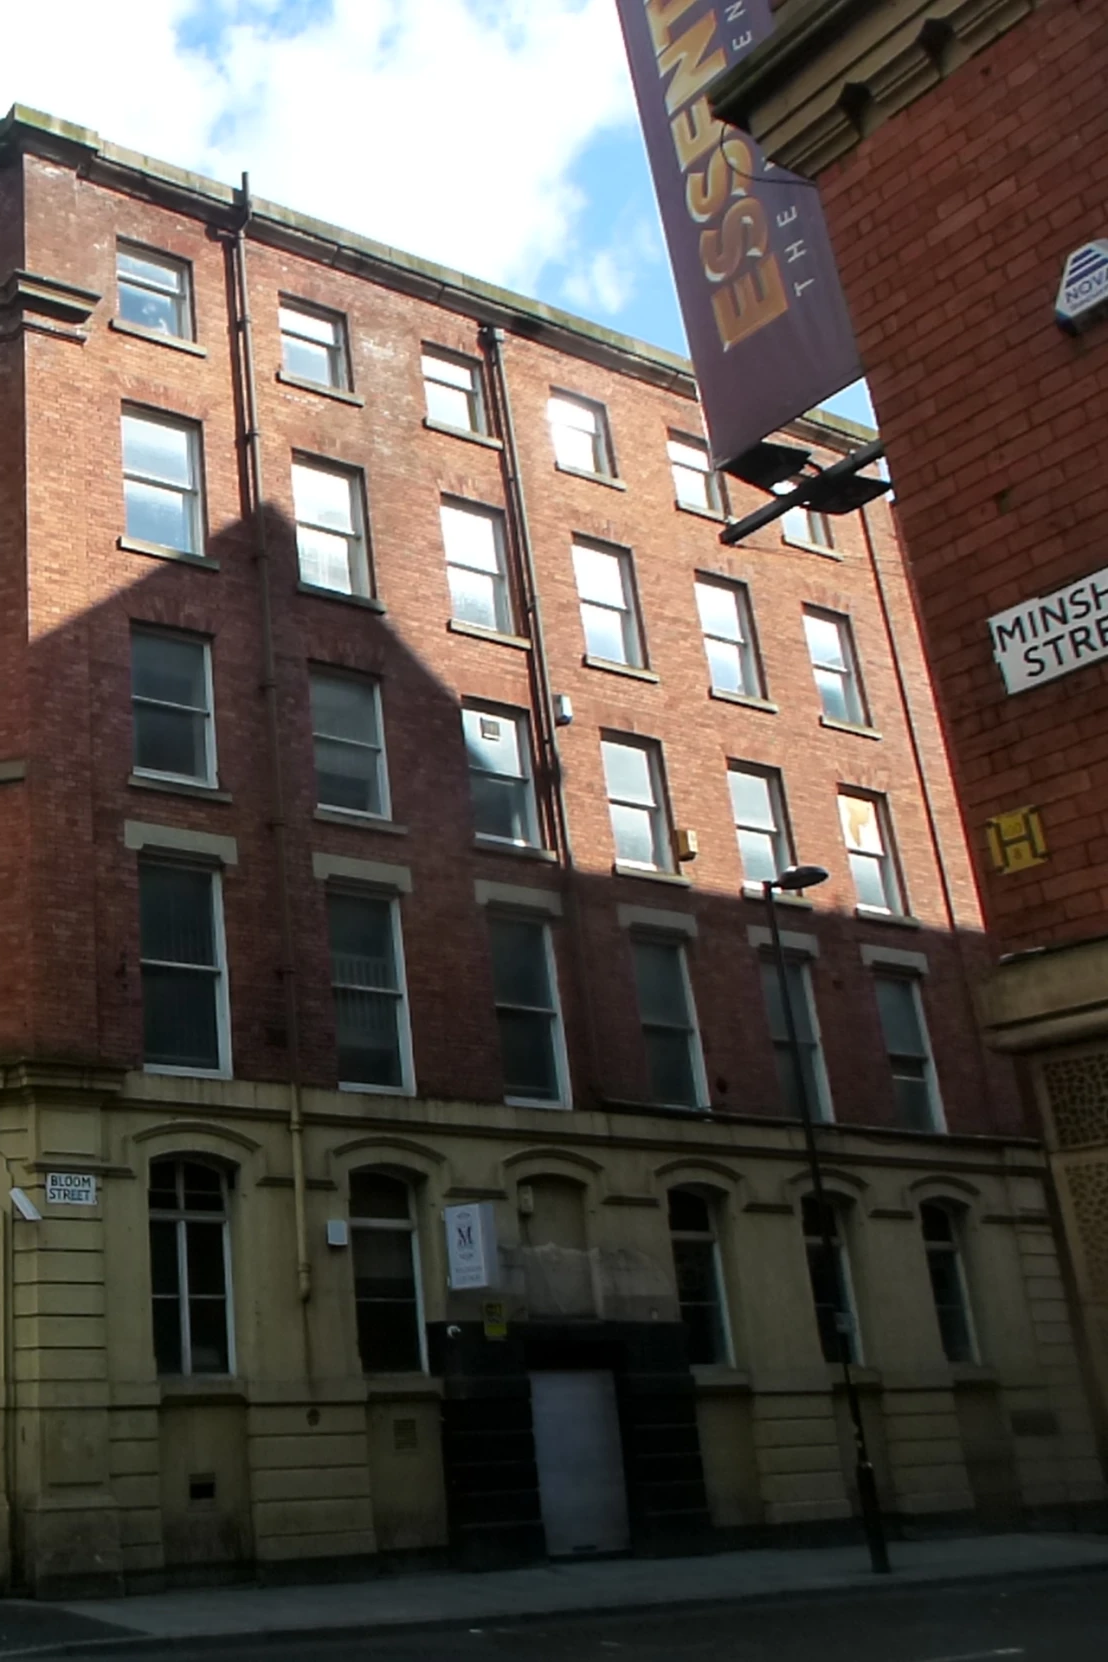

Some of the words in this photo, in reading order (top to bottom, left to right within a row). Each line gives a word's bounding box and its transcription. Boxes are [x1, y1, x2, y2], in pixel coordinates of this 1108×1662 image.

[776, 205, 815, 297] THE
[1065, 267, 1108, 304] NOV
[51, 1175, 91, 1188] BLOOM
[49, 1188, 90, 1201] STREET
